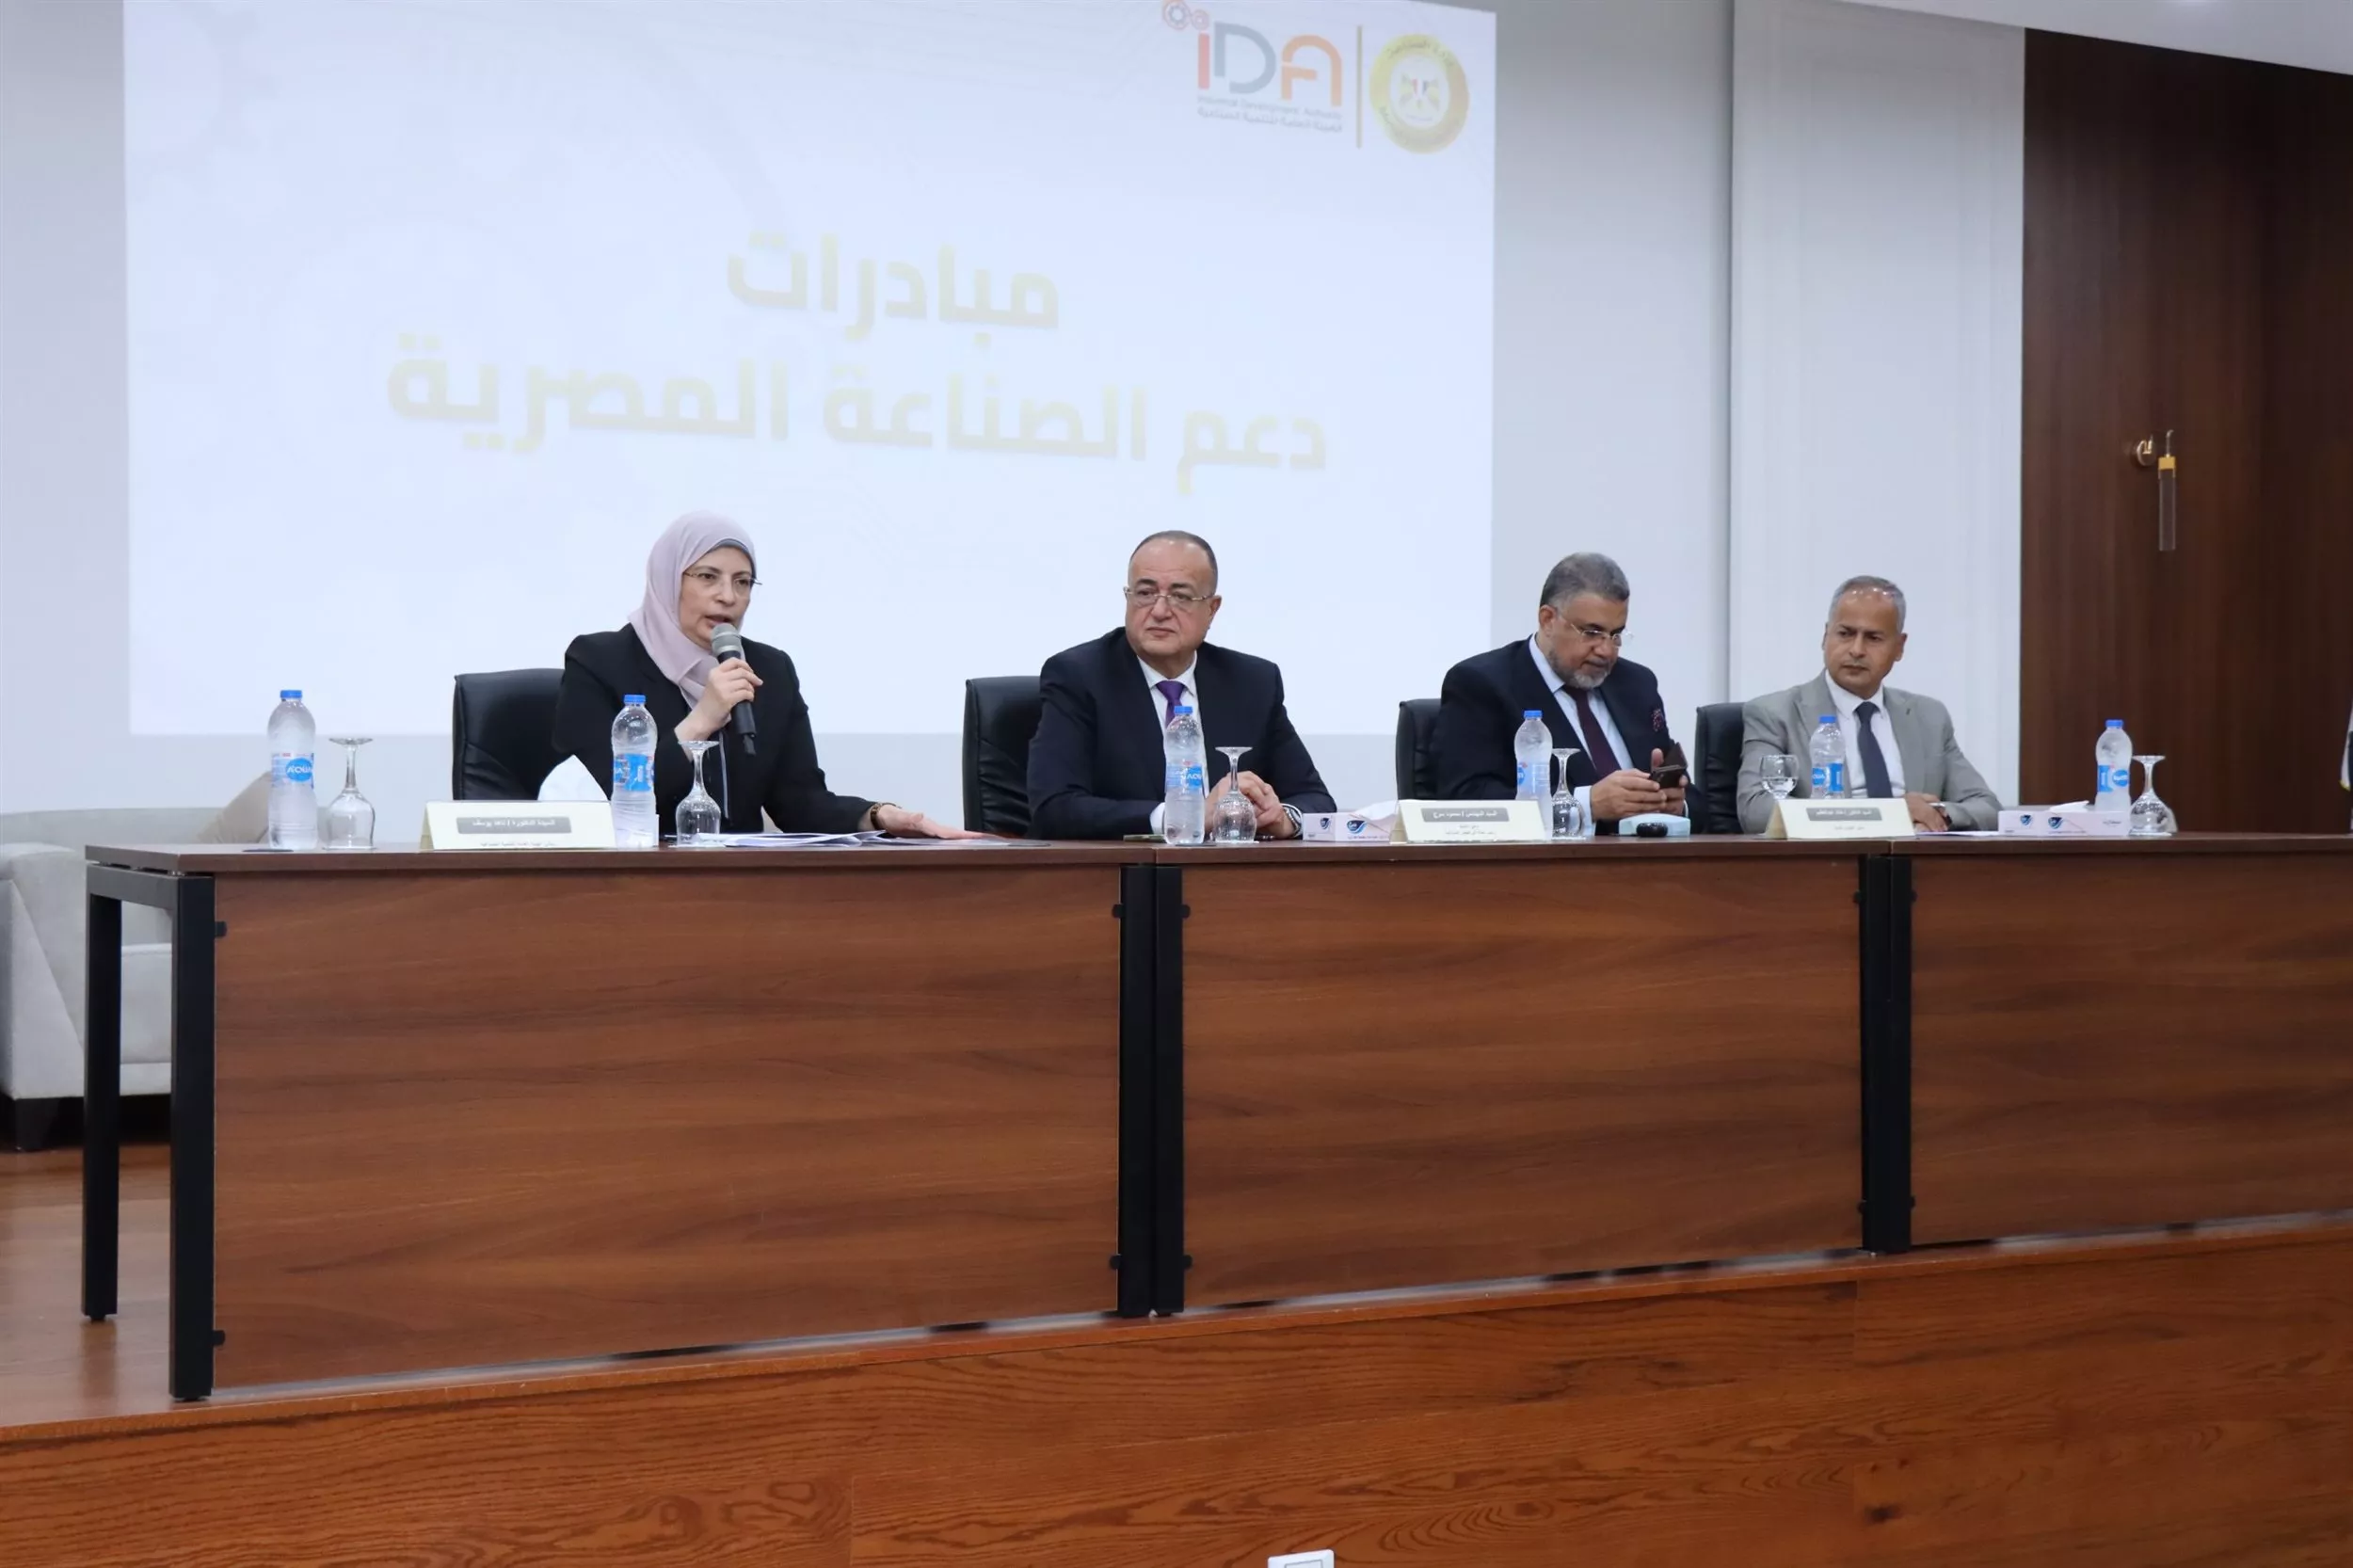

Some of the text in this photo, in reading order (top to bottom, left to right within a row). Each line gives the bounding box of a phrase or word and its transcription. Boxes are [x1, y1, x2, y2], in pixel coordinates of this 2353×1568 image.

[727, 232, 1060, 344] مبادرات
[387, 332, 1327, 495] دعم الصناعة المصرية
